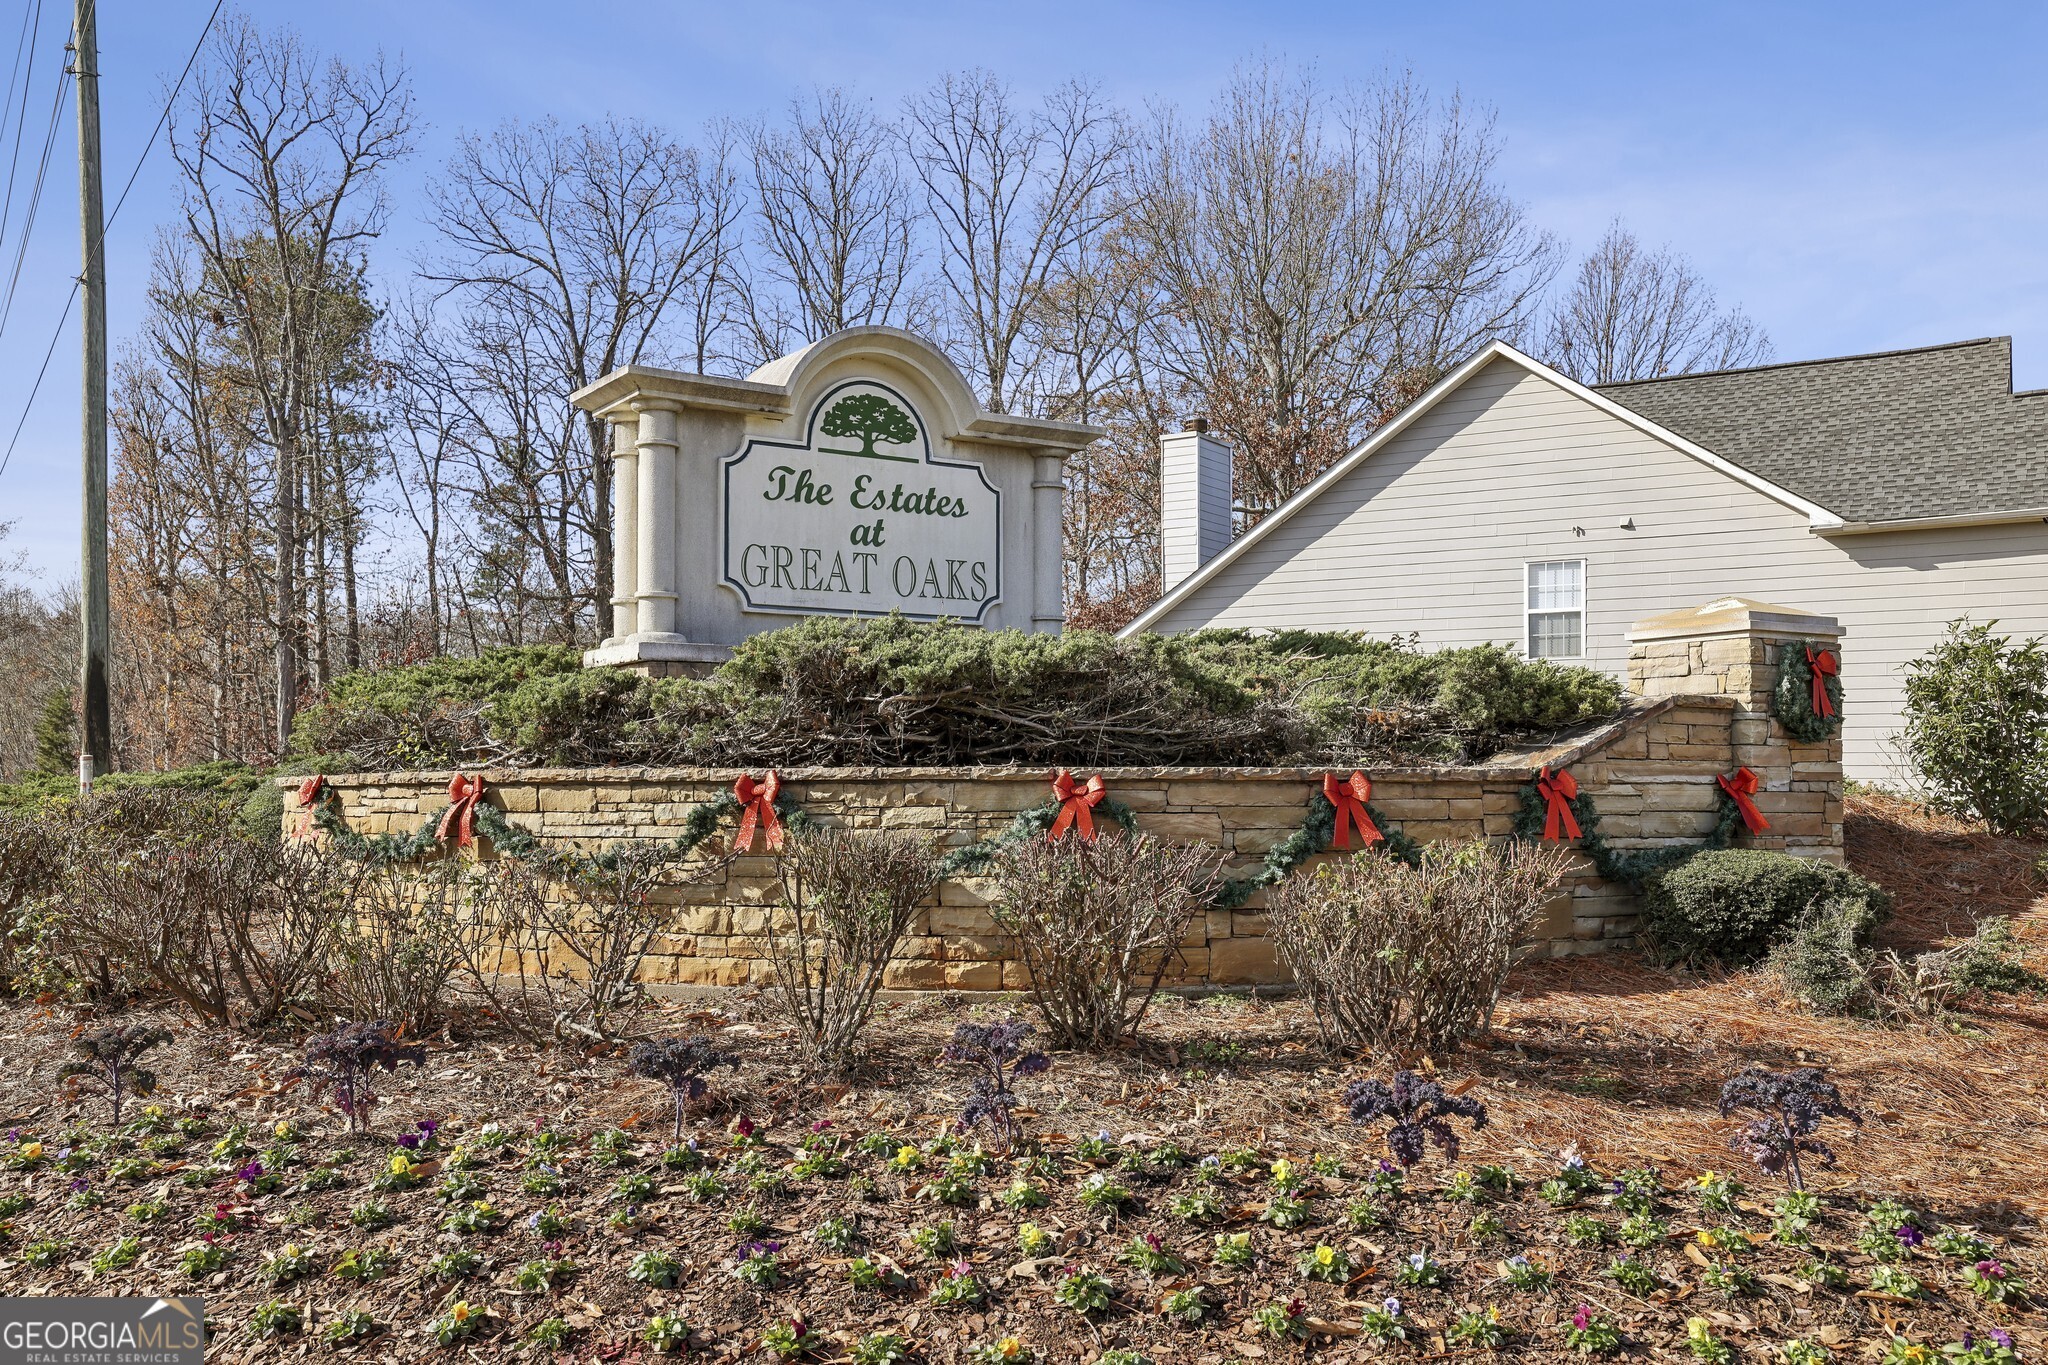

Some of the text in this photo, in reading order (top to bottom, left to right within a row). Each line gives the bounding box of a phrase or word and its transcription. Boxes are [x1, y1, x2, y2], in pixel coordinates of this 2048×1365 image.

[763, 465, 969, 518] The Estates
[850, 519, 885, 547] at
[740, 543, 988, 602] GREAT OAKS
